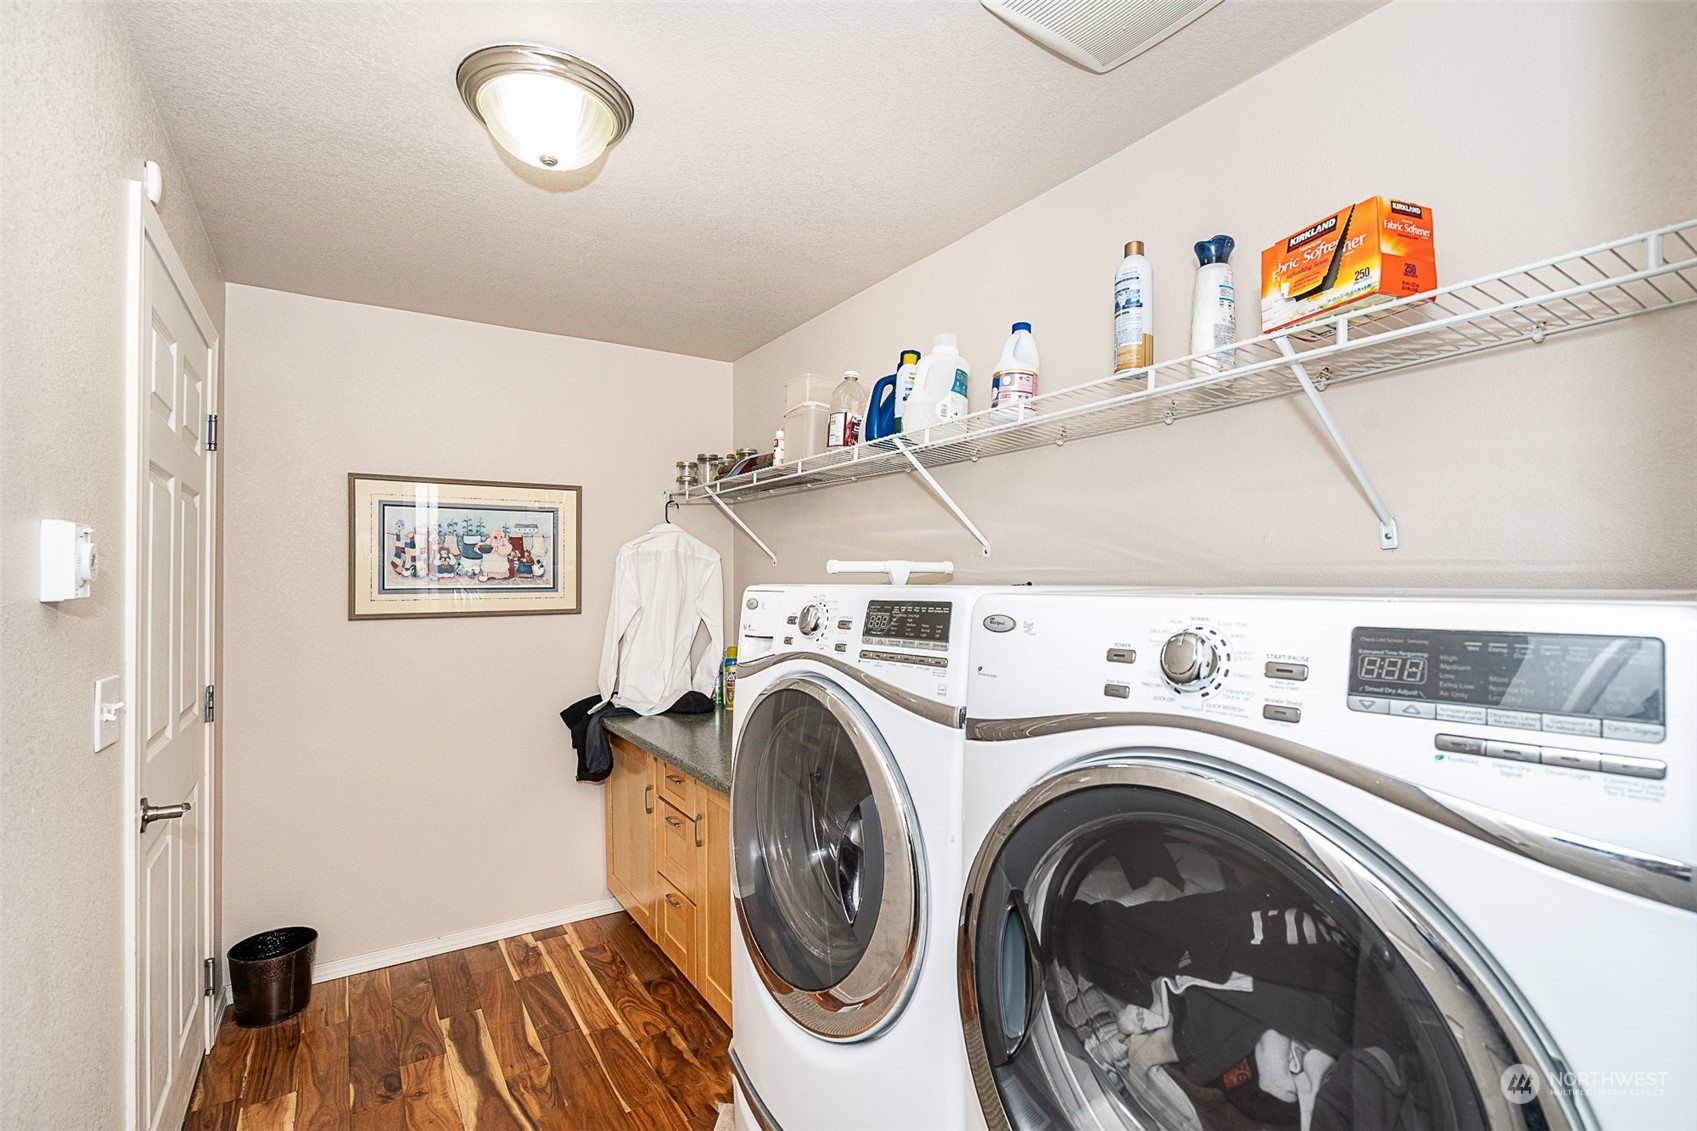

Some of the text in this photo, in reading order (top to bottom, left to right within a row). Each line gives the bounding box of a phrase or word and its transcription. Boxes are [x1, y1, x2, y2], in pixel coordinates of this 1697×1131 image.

[1392, 202, 1421, 214] KIRKLAND
[1289, 218, 1337, 247] KIRKLAND
[1383, 219, 1403, 232] Fabric
[1404, 223, 1431, 237] Softener
[1404, 262, 1417, 275] 250
[1354, 266, 1371, 281] 250
[1265, 653, 1310, 662] START/PAUSE
[1439, 654, 1459, 663] High
[1439, 663, 1472, 672] Medium
[1439, 672, 1456, 680] Low
[1459, 682, 1476, 690] Low
[1384, 687, 1396, 695] Dry
[1450, 691, 1470, 700] Only
